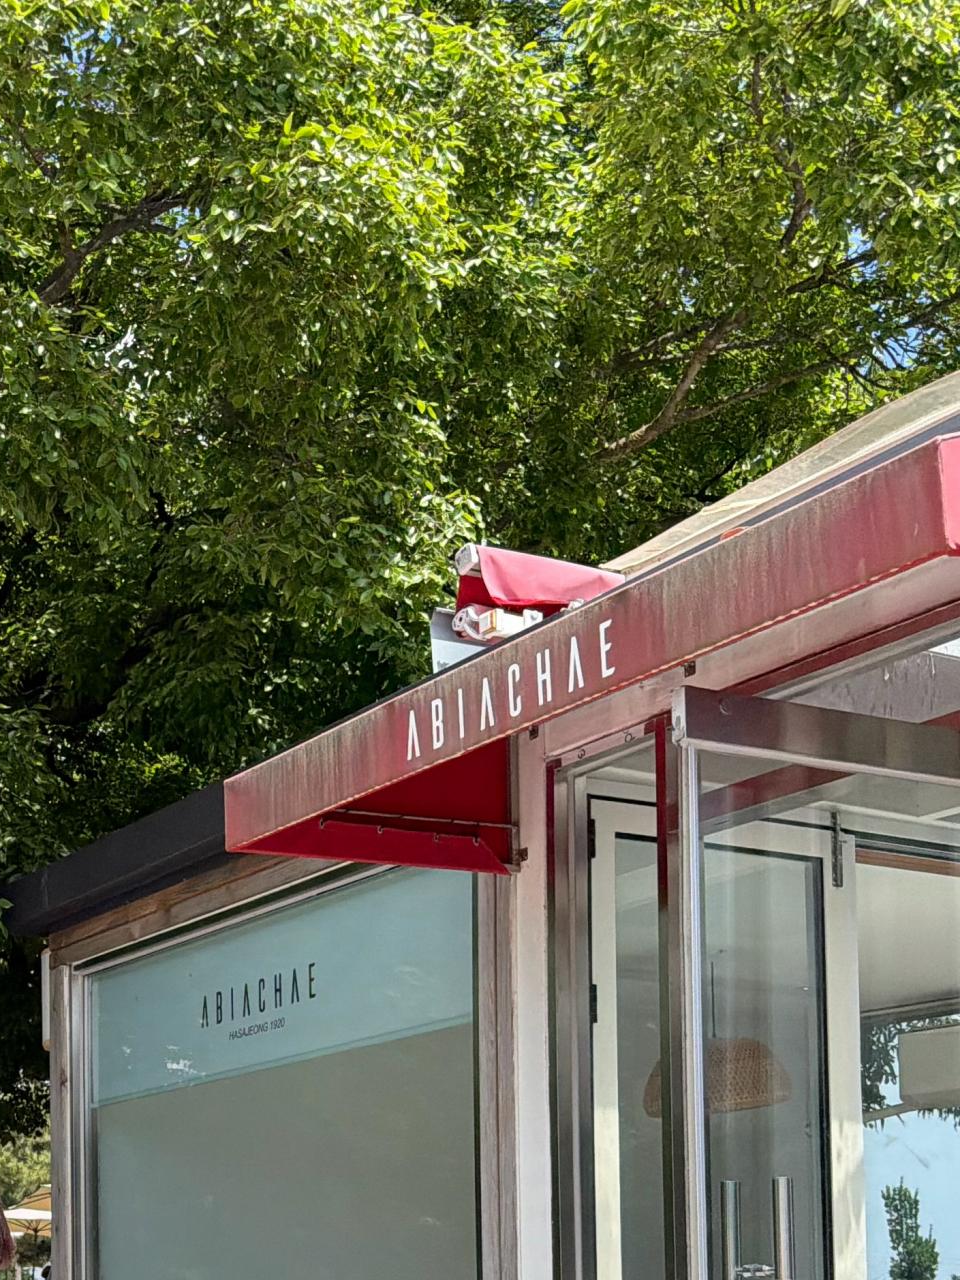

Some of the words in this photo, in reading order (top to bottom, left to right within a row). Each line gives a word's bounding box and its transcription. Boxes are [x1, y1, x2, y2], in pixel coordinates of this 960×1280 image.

[407, 618, 616, 761] ABIACHAE
[201, 962, 317, 1029] ABIACHAE
[228, 1022, 269, 1041] HASAJEONG
